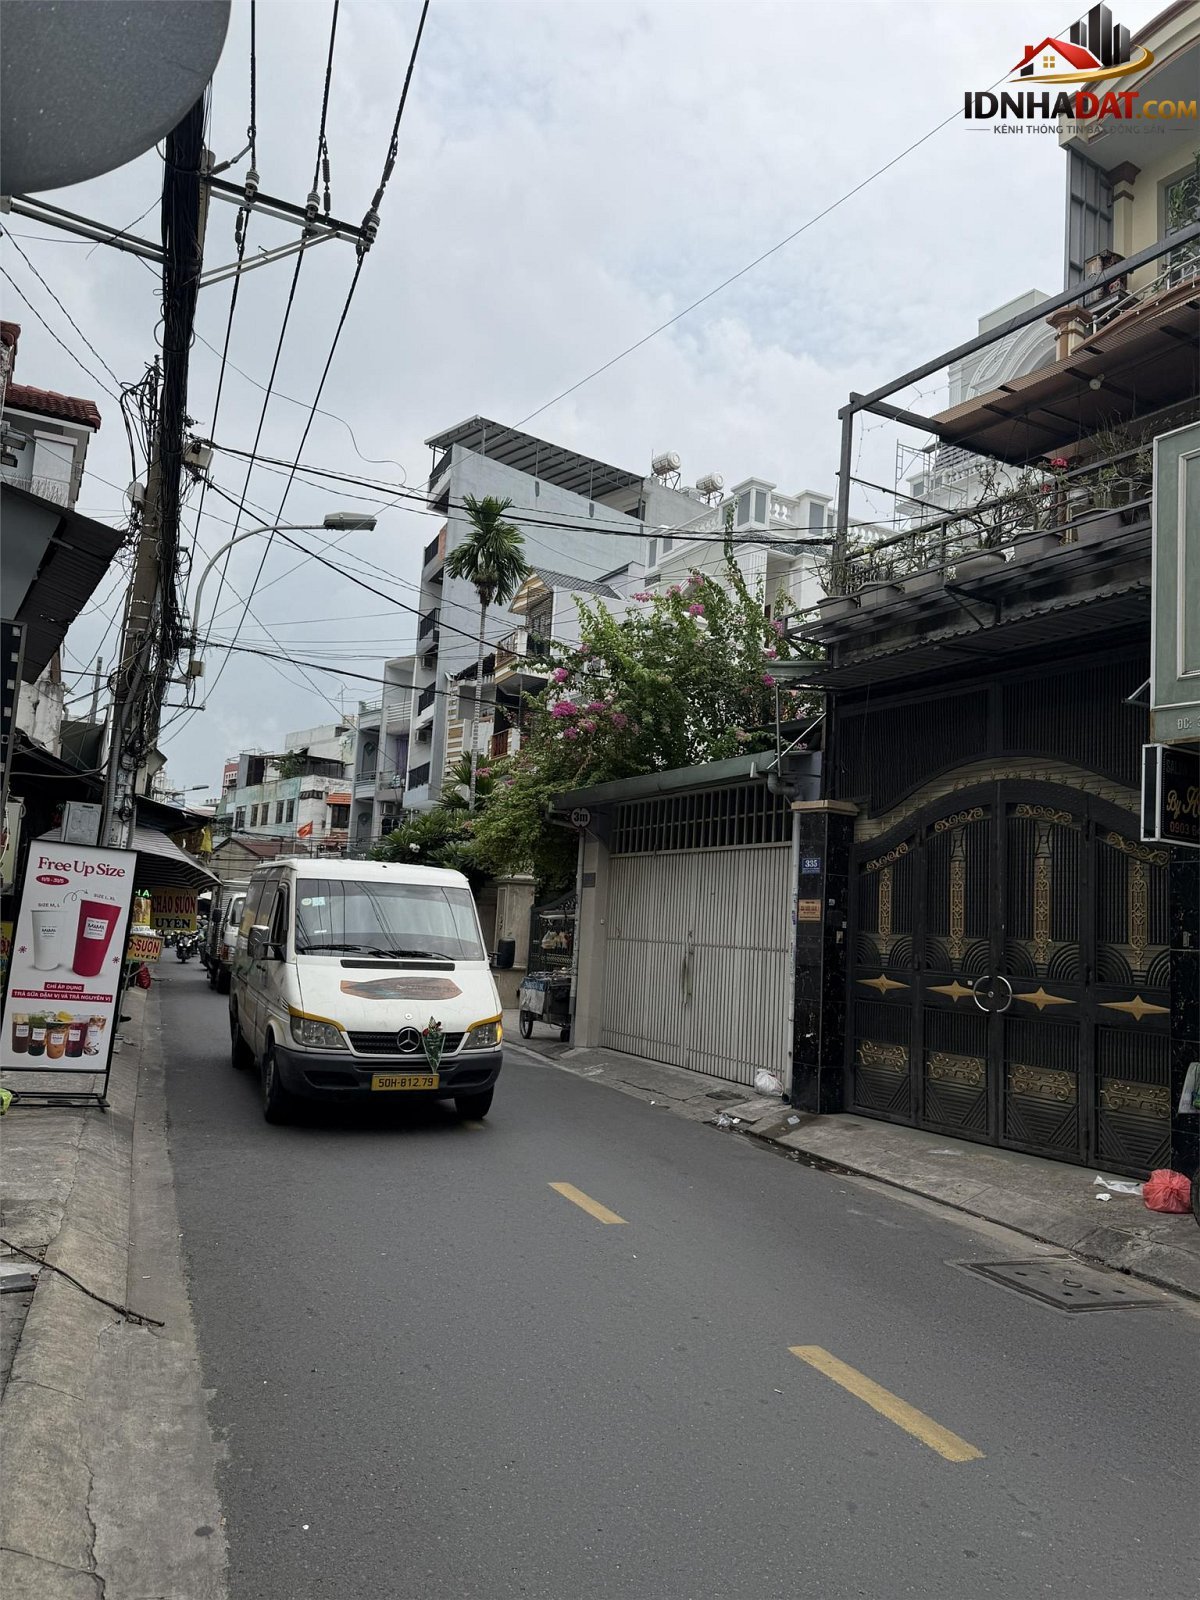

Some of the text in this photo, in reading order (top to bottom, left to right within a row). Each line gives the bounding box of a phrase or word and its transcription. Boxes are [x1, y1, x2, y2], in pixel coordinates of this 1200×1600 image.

[573, 812, 588, 823] 3m
[38, 856, 126, 878] Free Up Size
[804, 859, 818, 868] 335
[378, 1077, 434, 1088] 50H-812.79
